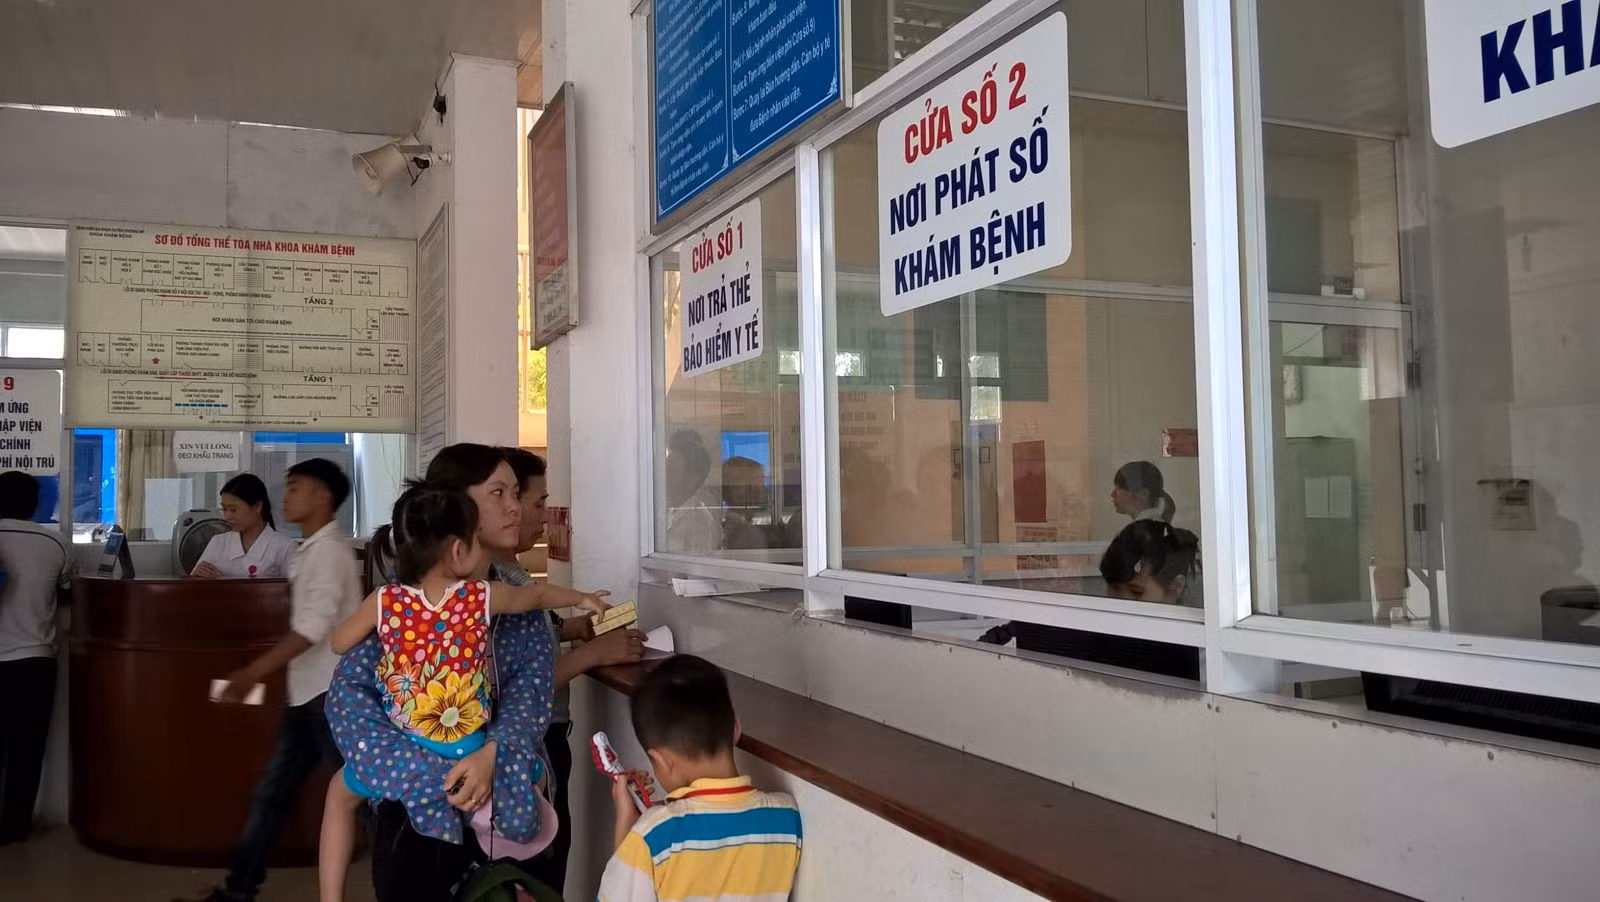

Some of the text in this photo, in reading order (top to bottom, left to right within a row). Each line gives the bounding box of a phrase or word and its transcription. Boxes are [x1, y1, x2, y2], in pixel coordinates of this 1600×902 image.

[904, 61, 1027, 164] CỬA SỐ 2
[890, 104, 1049, 235] NƠI PHÁT SỐ
[155, 234, 168, 245] SƠ
[275, 242, 300, 253] KHOA
[692, 216, 743, 273] CỬA SỐ 1
[894, 201, 1046, 296] KHÁM BỆNH
[688, 261, 751, 327] NƠI TRẢ THẺ
[684, 308, 759, 372] BẢO HIỂM Y TẾ
[4, 376, 14, 391] 9
[8, 399, 29, 413] ỨNG
[0, 436, 31, 450] CHÍNH
[19, 418, 42, 434] VIỆN
[16, 454, 33, 471] NỘI
[36, 454, 55, 468] TRÚ
